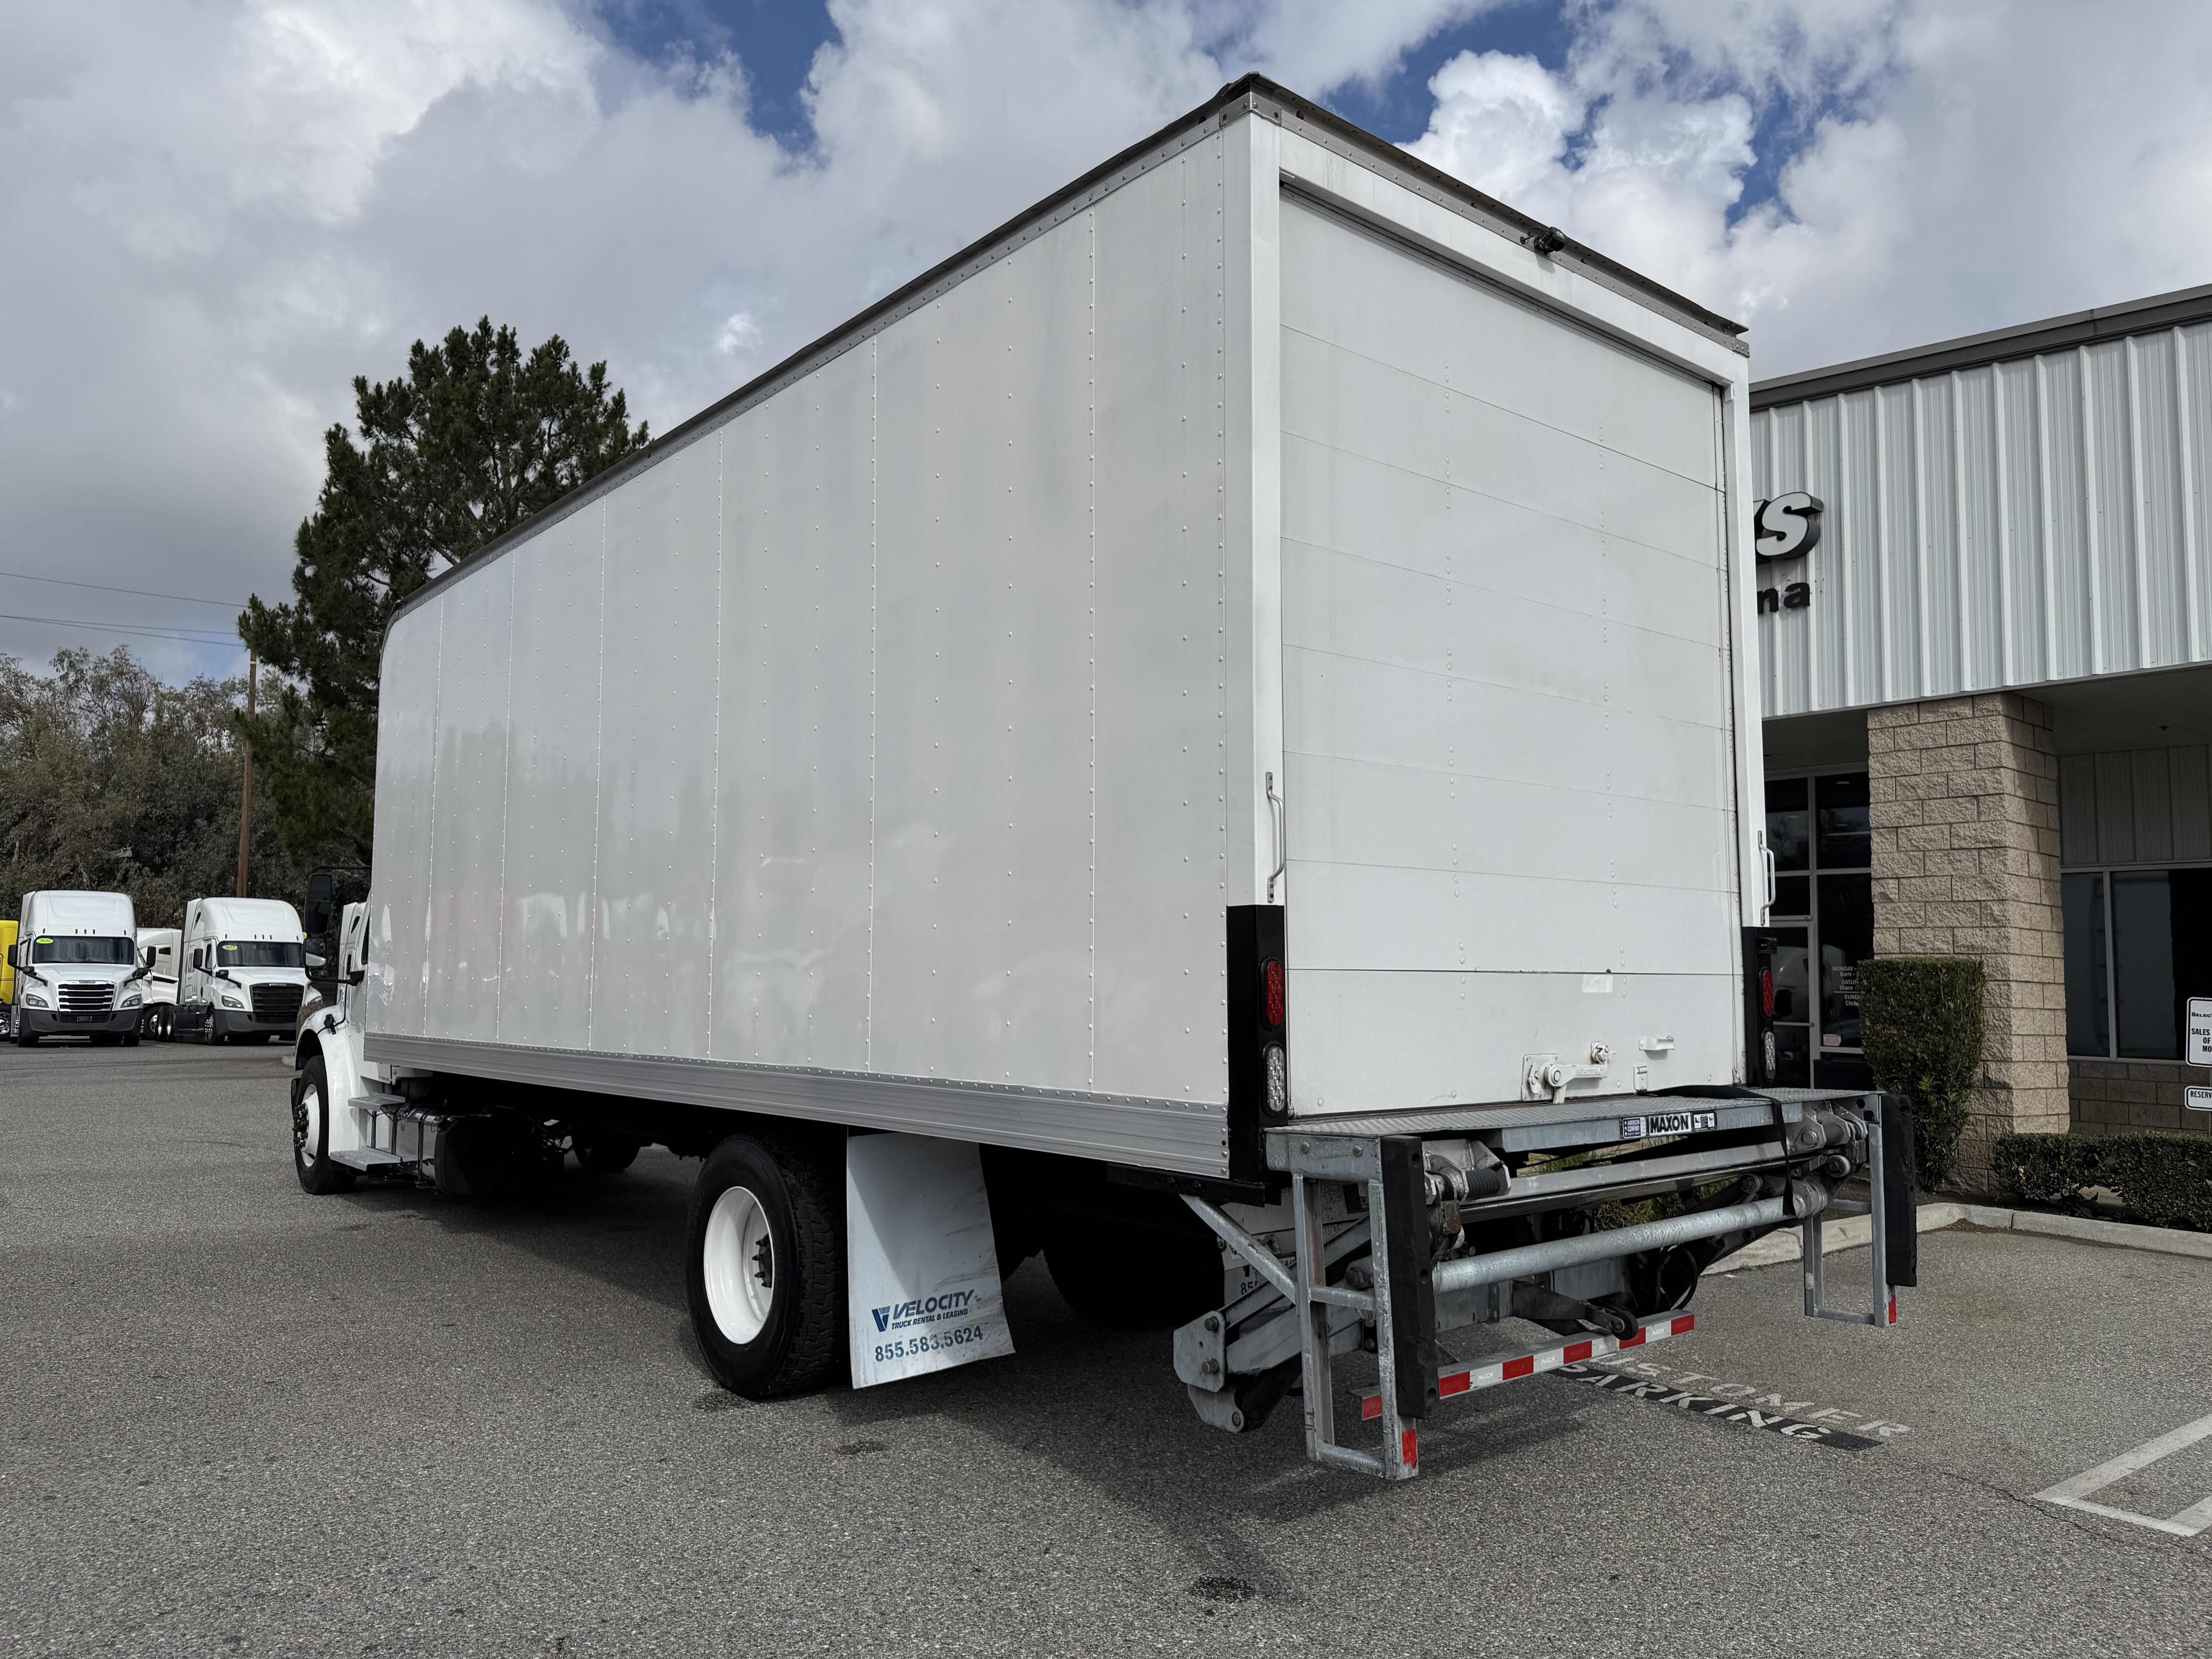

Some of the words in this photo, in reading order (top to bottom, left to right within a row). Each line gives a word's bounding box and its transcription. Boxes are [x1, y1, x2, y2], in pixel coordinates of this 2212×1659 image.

[1650, 1115, 1689, 1133] MAXON
[893, 1289, 975, 1320] VELOCITY
[891, 1319, 912, 1329] TRUCK
[913, 1315, 935, 1325] RENTAL
[943, 1308, 968, 1319] LEASING
[1478, 1372, 1494, 1381] MAXON
